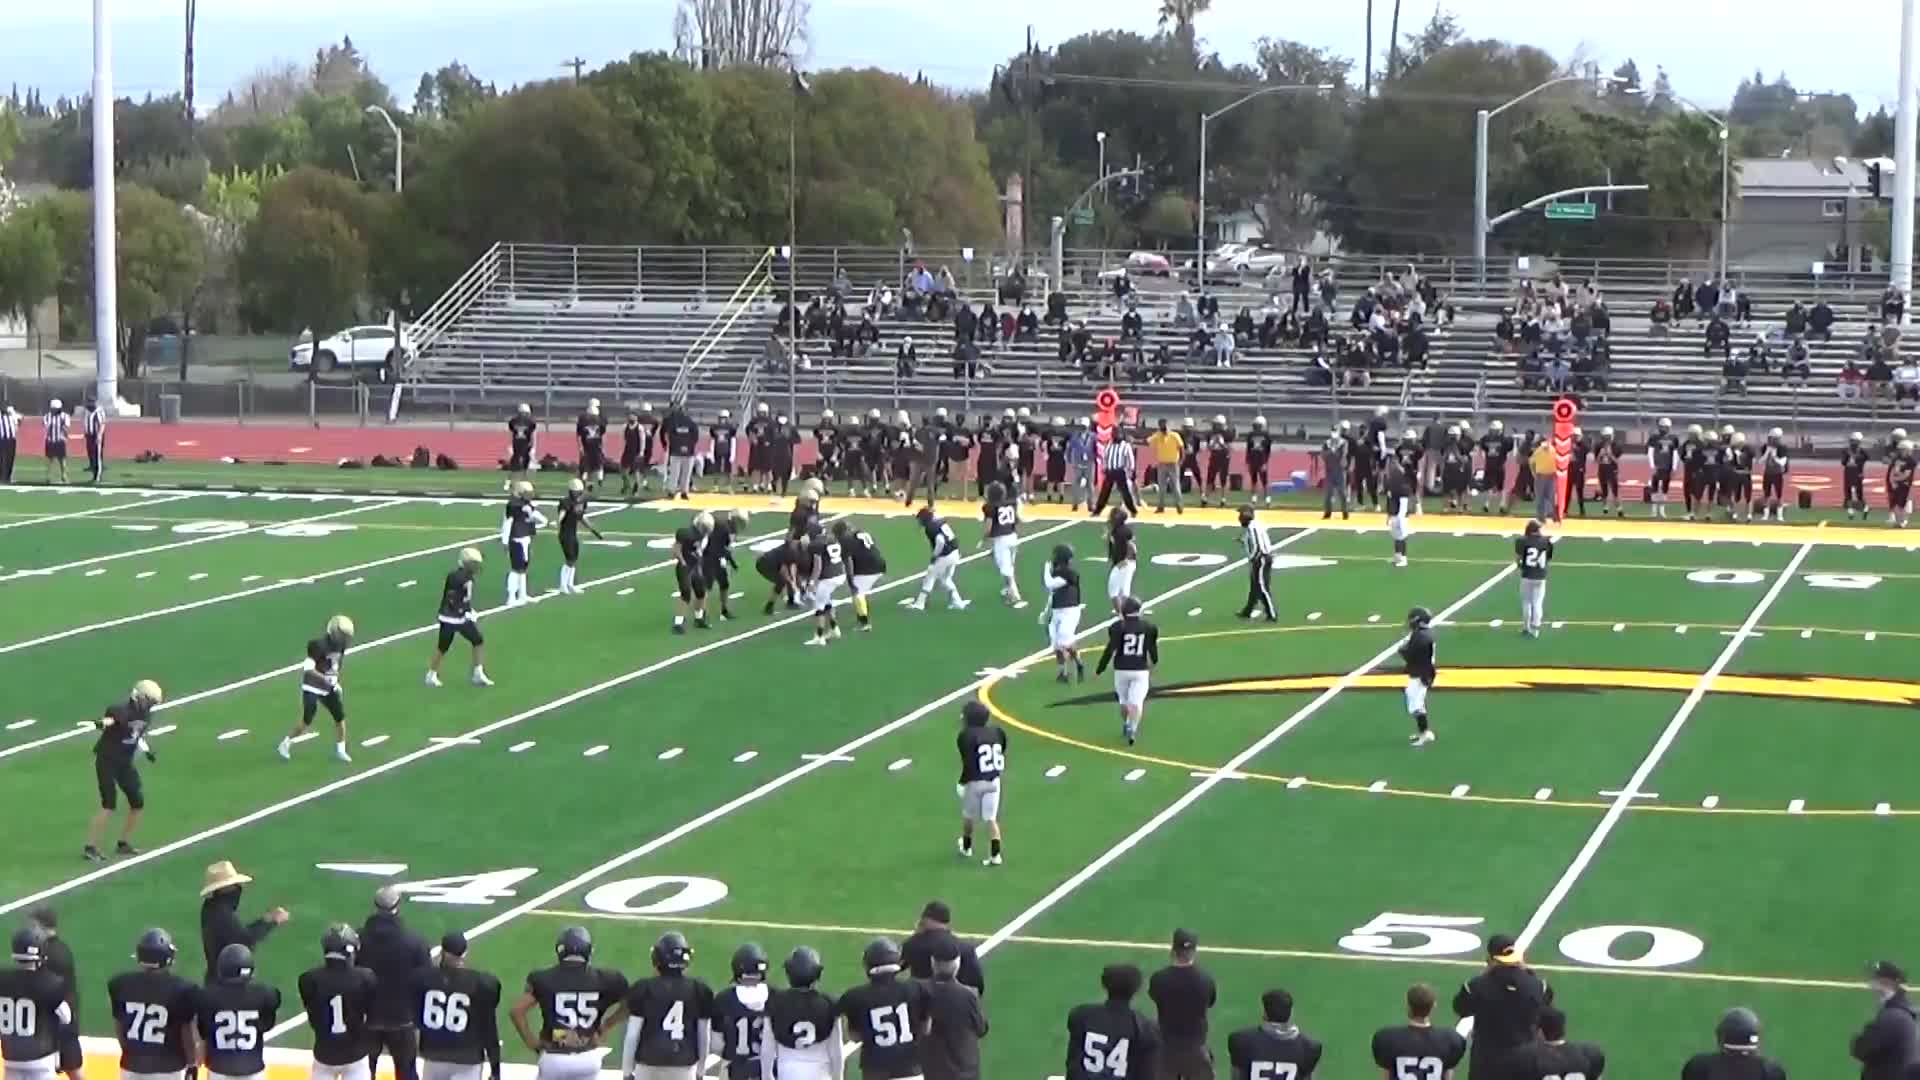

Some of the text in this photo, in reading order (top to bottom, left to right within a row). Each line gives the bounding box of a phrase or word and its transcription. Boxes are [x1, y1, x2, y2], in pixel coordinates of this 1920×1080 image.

[998, 505, 1015, 525] 20
[1526, 547, 1547, 568] 24
[1123, 633, 1145, 655] 21
[978, 744, 1005, 772] 26
[125, 1001, 168, 1044] 72
[214, 1009, 260, 1050] 25
[329, 994, 347, 1033] 1
[423, 989, 471, 1032] 66
[555, 991, 600, 1029] 55
[662, 1000, 685, 1040] 4
[869, 1002, 914, 1047] 51
[1082, 1031, 1130, 1078] 54
